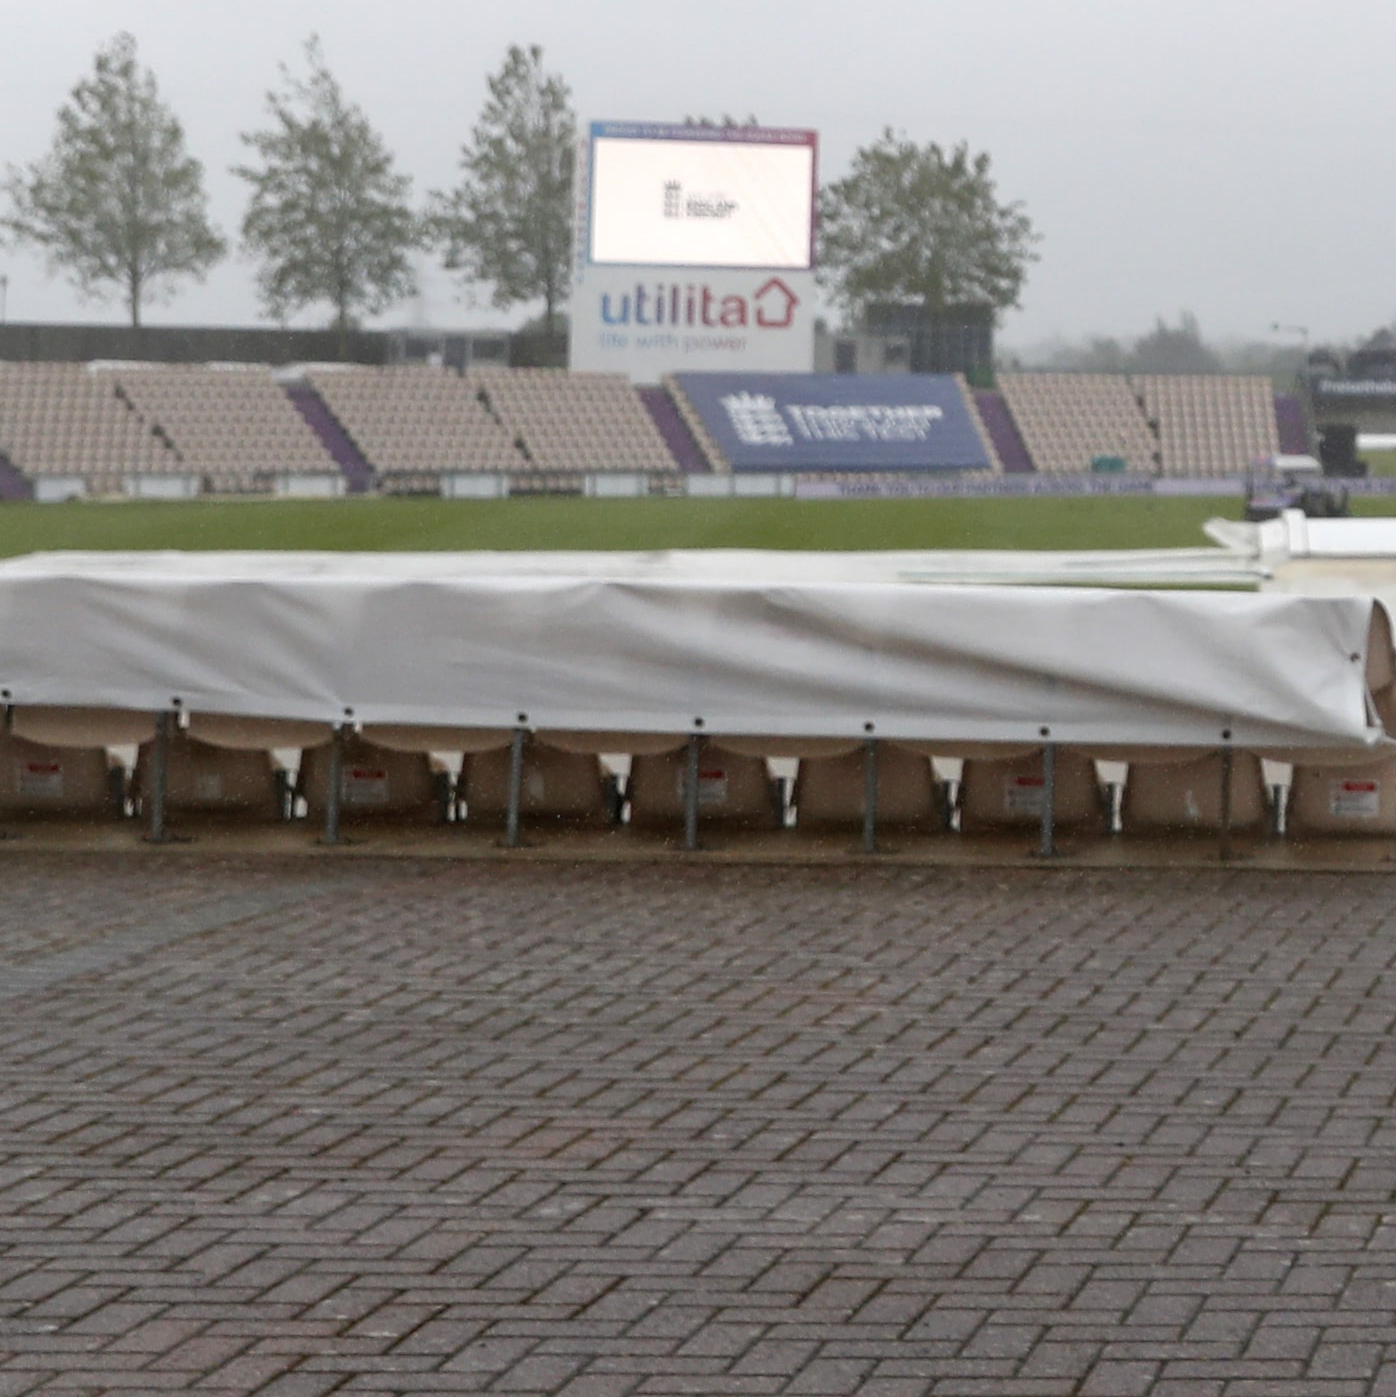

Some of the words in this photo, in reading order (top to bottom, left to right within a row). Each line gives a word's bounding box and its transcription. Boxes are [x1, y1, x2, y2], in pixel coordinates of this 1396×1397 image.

[600, 282, 748, 327] utilita
[600, 332, 628, 349] life
[636, 334, 679, 349] with
[684, 335, 748, 353] power
